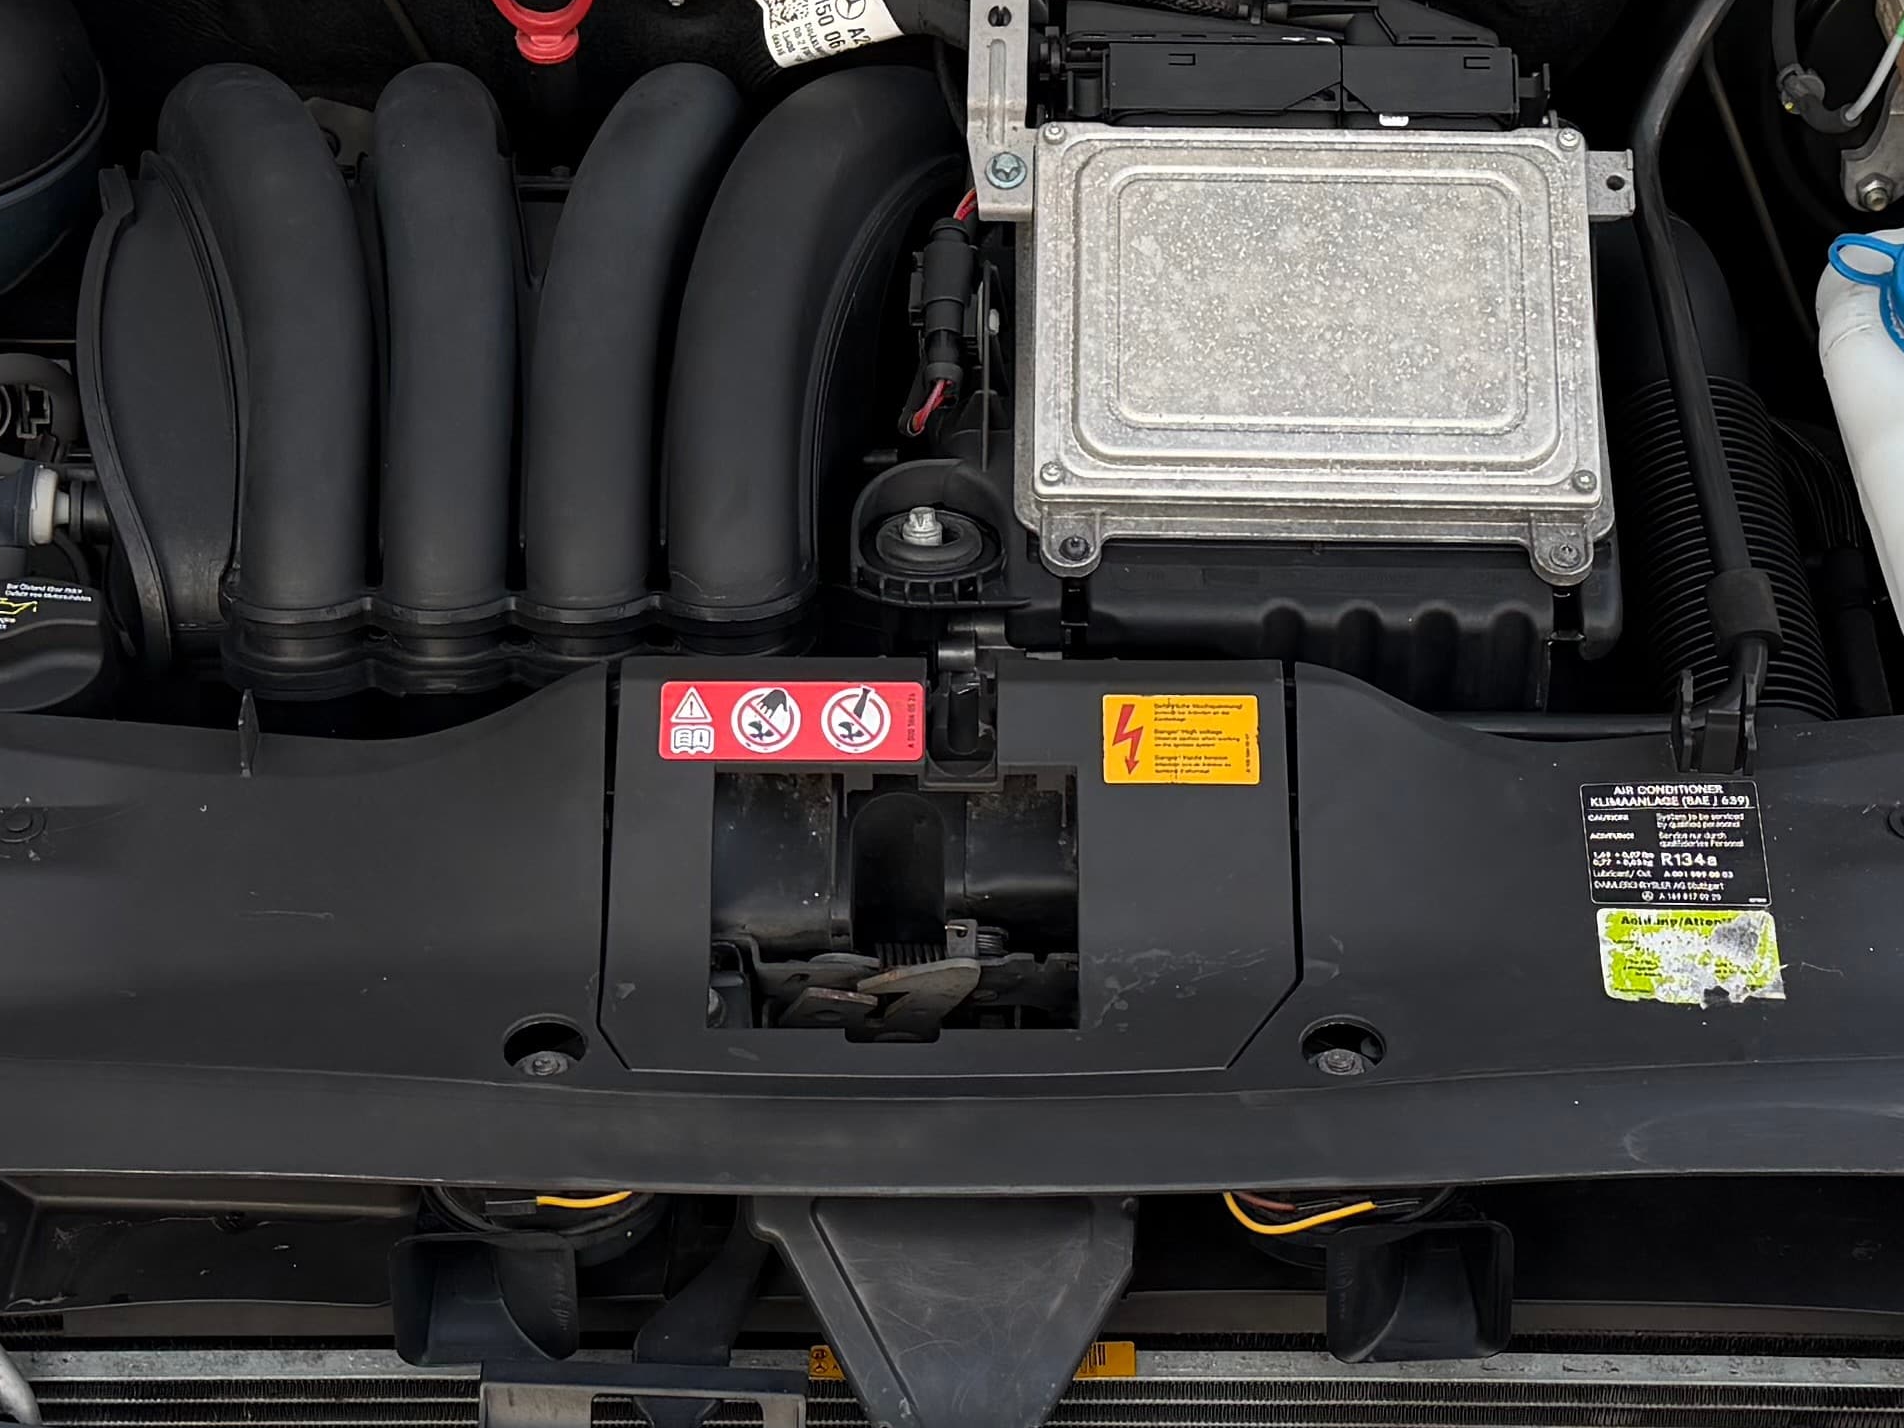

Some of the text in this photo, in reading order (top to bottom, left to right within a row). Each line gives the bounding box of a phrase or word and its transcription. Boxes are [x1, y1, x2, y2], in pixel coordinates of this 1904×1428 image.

[1614, 784, 1724, 795] AIR CONDITIONER
[1590, 796, 1679, 807] KLIMAANLAGE
[1722, 796, 1750, 808] 639)
[1660, 852, 1718, 867] R134a
